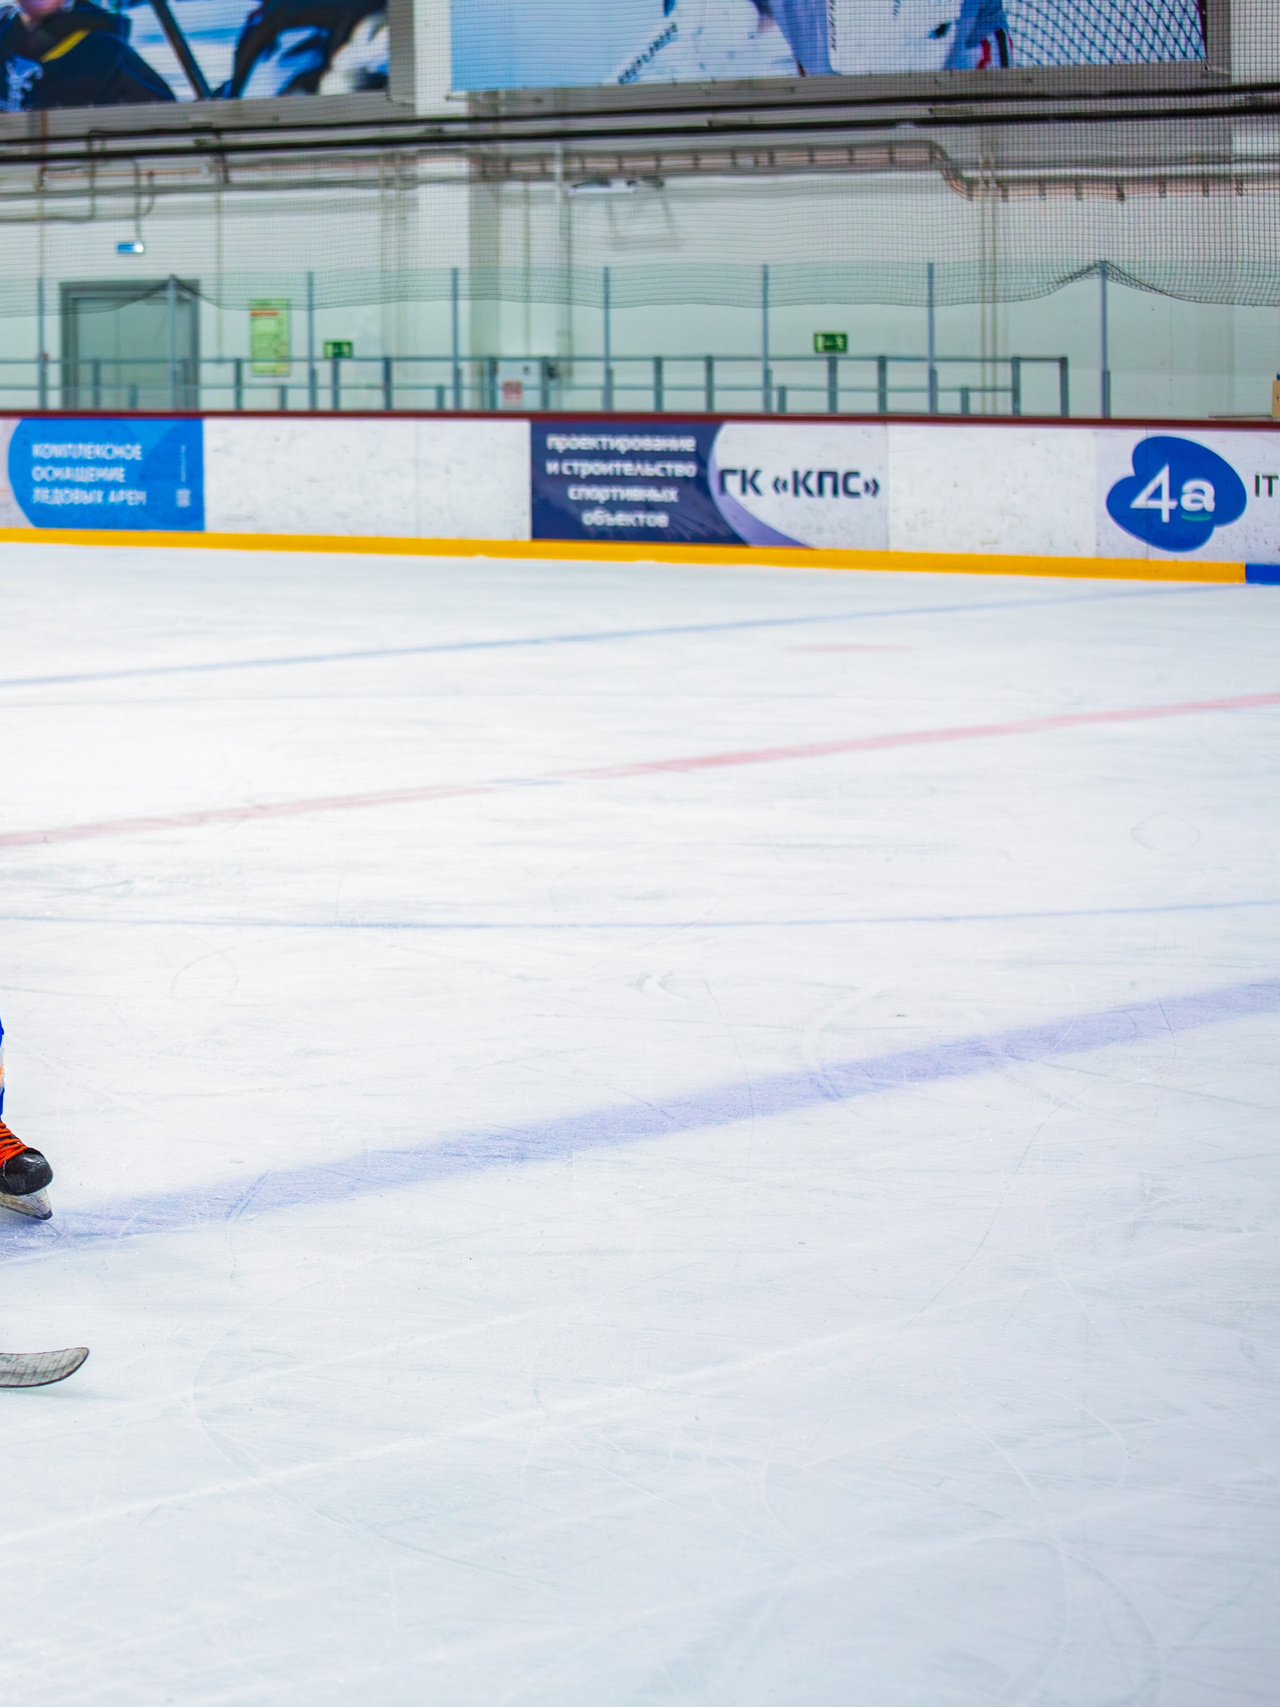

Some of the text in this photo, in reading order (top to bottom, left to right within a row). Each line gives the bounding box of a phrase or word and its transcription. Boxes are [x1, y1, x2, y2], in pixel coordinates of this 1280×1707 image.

[32, 443, 142, 460] КОМПЛЕКСНОЕ
[546, 434, 697, 454] проектирование
[31, 465, 126, 483] ОСНАЩЕНИЕ
[561, 458, 698, 479] строительство
[719, 468, 881, 499] ГК «КПС»
[1130, 463, 1216, 523] 4a
[33, 486, 147, 506] ЛЕДОВЫХ АРЕН
[568, 484, 679, 504] спортивных
[582, 507, 669, 527] объектов
